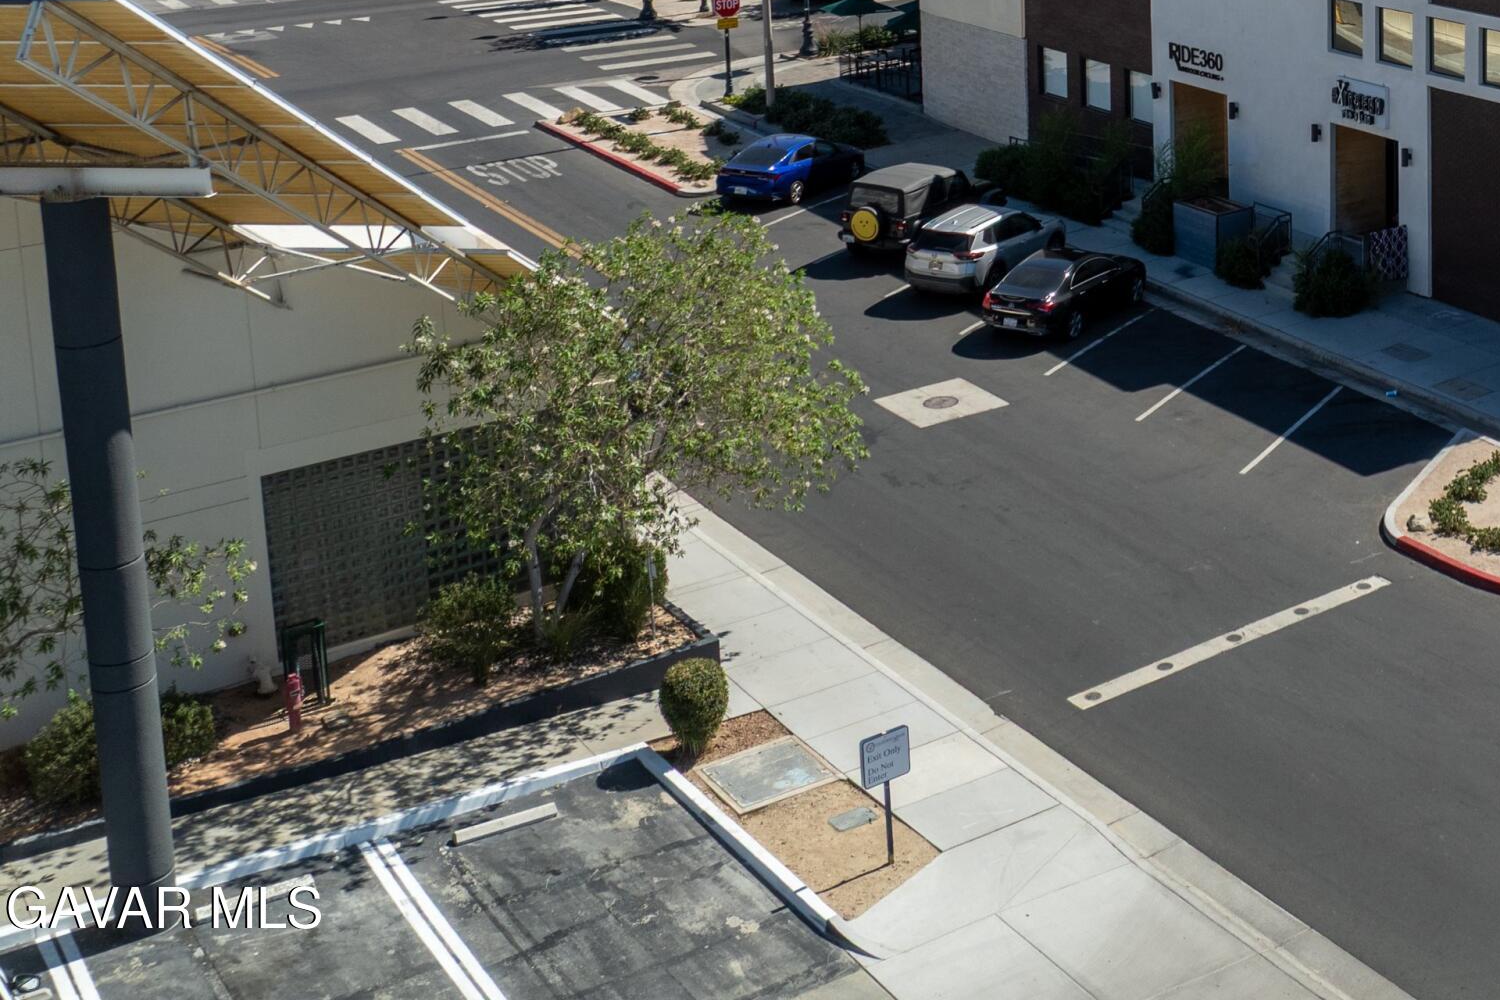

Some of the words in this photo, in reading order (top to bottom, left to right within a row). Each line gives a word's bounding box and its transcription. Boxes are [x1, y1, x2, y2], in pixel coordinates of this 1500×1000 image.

[716, 0, 739, 10] STOP
[1168, 41, 1223, 71] RIDE360
[466, 155, 562, 186] STOP
[867, 752, 882, 764] Exit
[883, 745, 900, 757] Only
[868, 767, 879, 776] Do
[880, 761, 894, 769] Not
[868, 772, 887, 784] Enter
